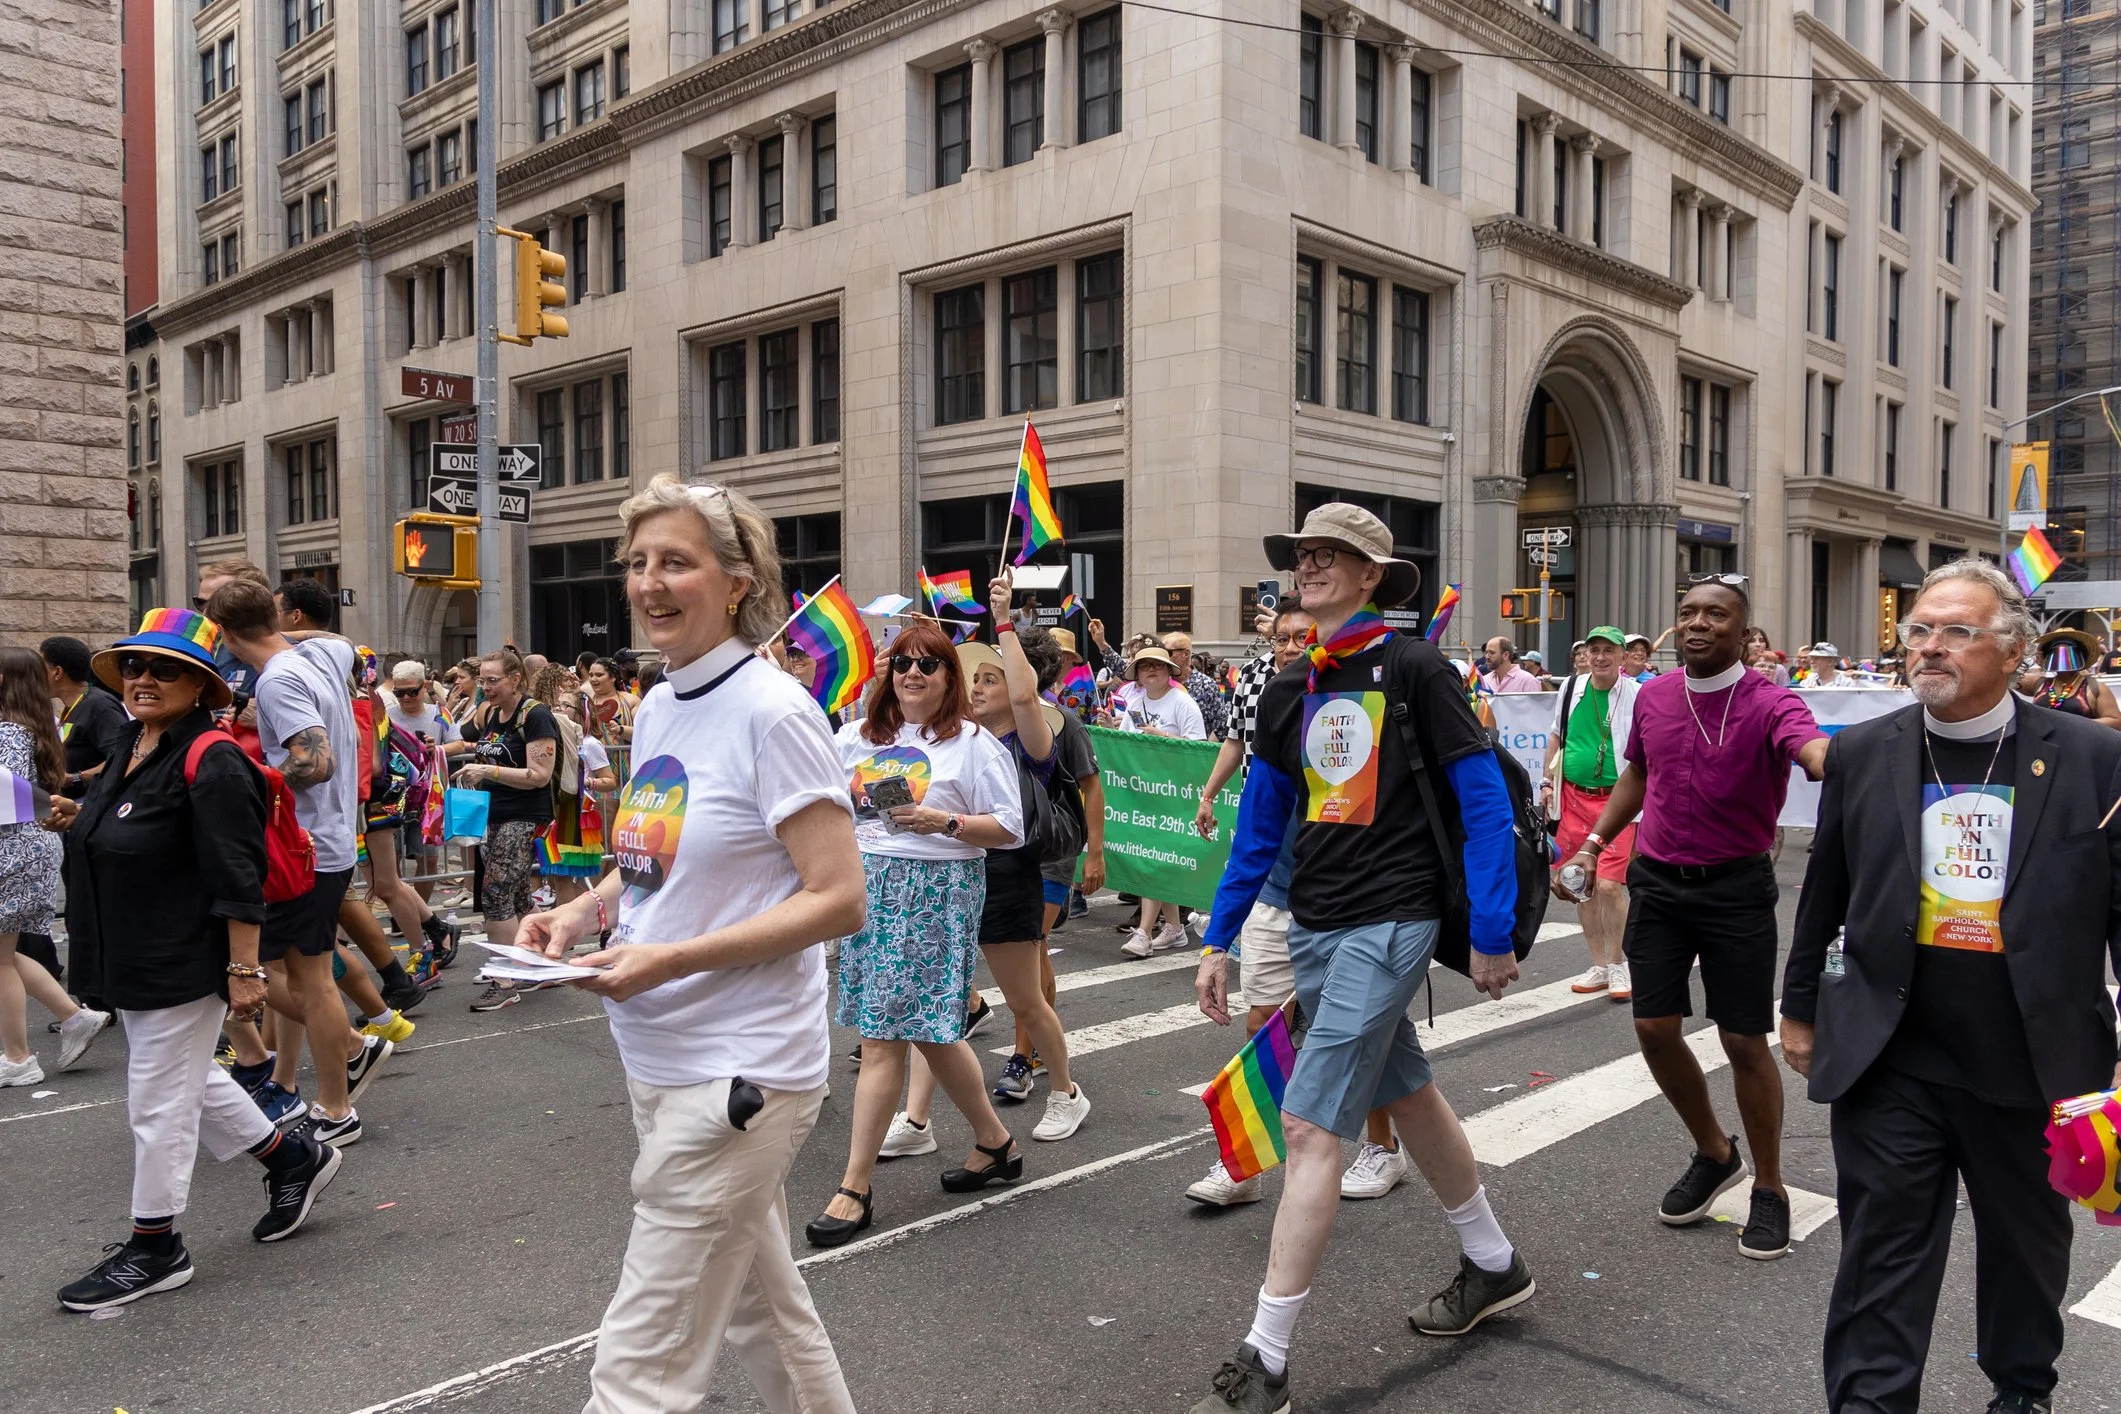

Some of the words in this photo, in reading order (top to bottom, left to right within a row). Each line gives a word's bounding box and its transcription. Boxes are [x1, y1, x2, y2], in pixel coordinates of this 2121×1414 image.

[420, 377, 428, 395] 5
[435, 379, 455, 398] Av
[444, 427, 452, 443] W
[454, 425, 465, 442] 20
[468, 420, 477, 441] St
[443, 489, 474, 506] ONE
[499, 496, 522, 511] AY
[1530, 534, 1543, 542] ONE
[1549, 533, 1564, 541] WAY
[1533, 551, 1542, 560] ONE
[343, 589, 351, 605] R
[1168, 592, 1180, 602] 156
[1042, 608, 1060, 616] NEVER
[1321, 715, 1356, 727] FAITH
[1331, 729, 1344, 740] IN
[1502, 725, 1547, 749] ien
[476, 743, 503, 756] Mom
[1324, 742, 1351, 754] FULL
[875, 762, 913, 774] FAITH
[1320, 756, 1354, 768] COLOR
[1105, 770, 1128, 789] The
[1129, 775, 1177, 797] Church
[1180, 783, 1193, 800] of
[1196, 785, 1218, 804] te
[629, 790, 668, 810] FAITH
[629, 811, 647, 828] IN
[1104, 805, 1129, 823] One
[1132, 810, 1157, 829] East
[1159, 814, 1185, 835] 29th
[1940, 813, 2003, 828] FAITH
[617, 830, 648, 851] FULL
[1104, 839, 1197, 871] www.littlechurch.org
[1944, 846, 1999, 862] FULL
[616, 851, 653, 875] COLOR
[1934, 862, 2006, 880] COLOR
[1956, 908, 1984, 918] SAINT
[1950, 926, 1989, 935] CHURCH
